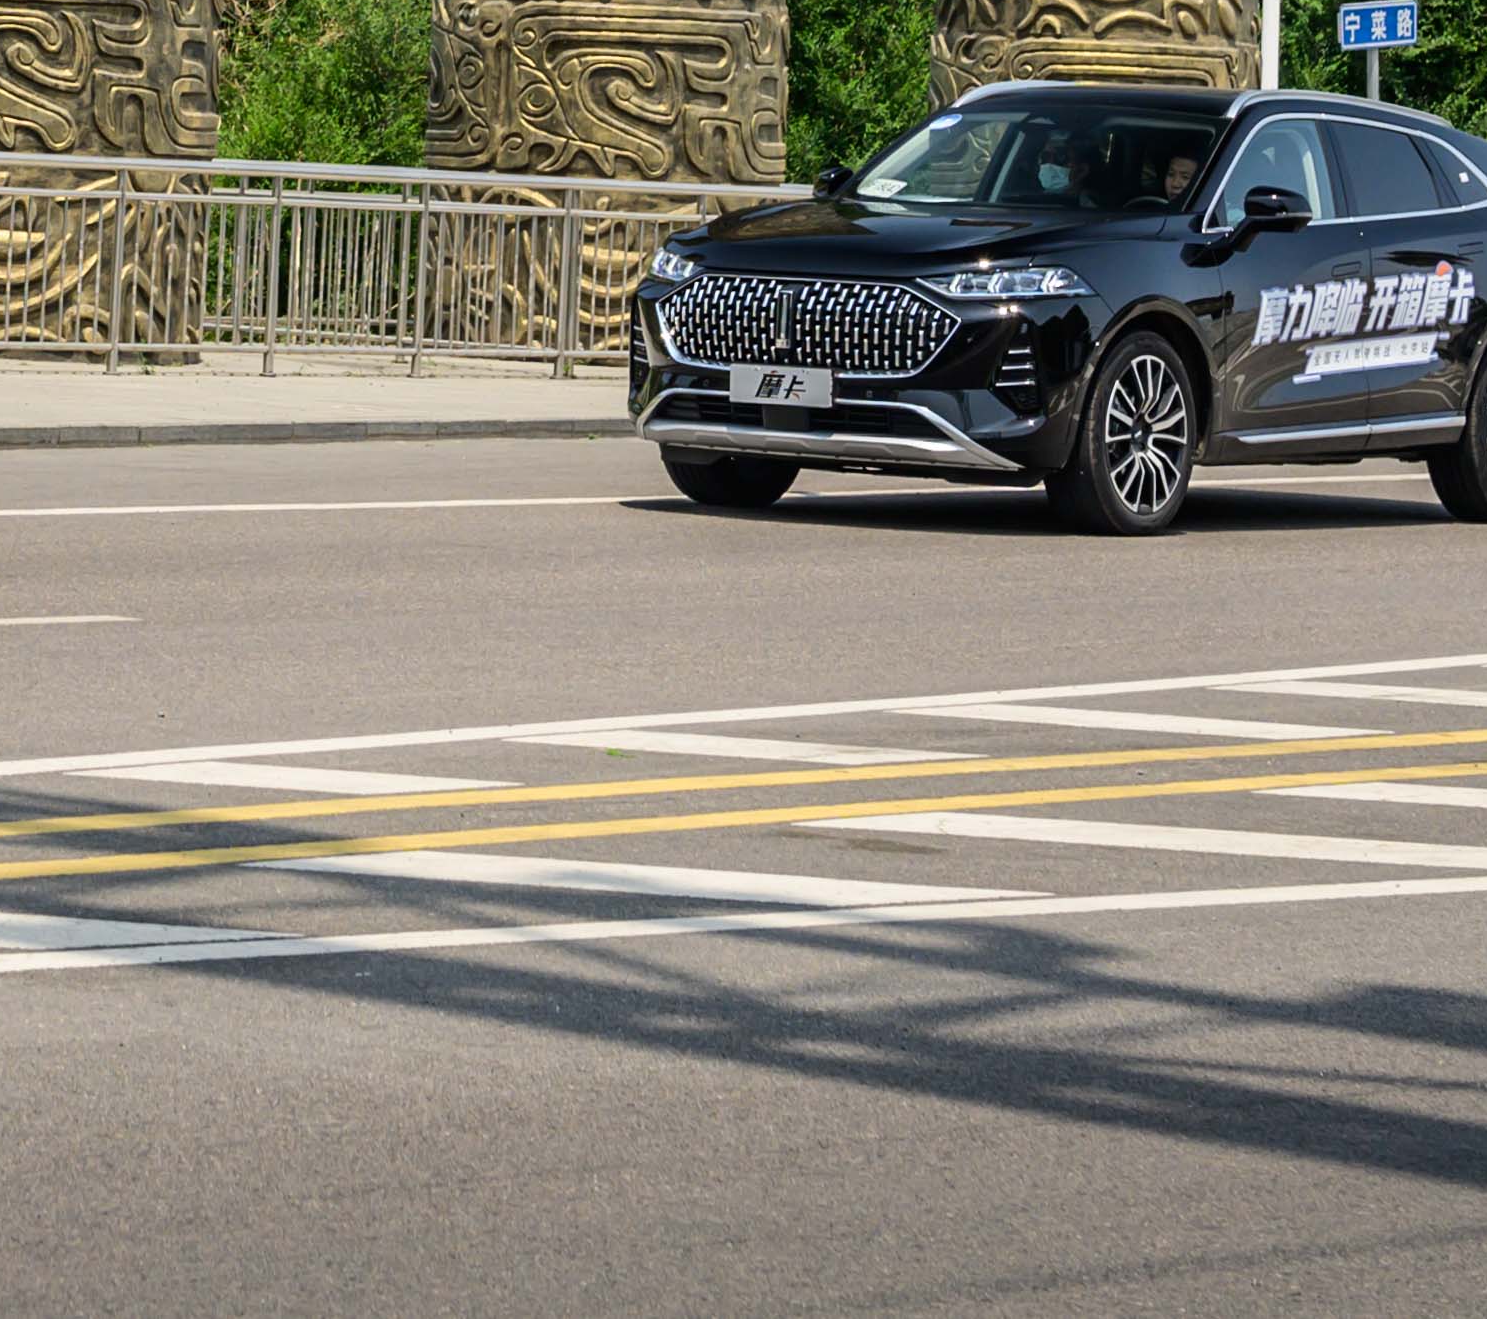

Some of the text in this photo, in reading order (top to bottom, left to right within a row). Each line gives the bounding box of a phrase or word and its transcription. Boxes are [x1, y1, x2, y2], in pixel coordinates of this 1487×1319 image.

[1364, 265, 1475, 332] 开箱摩卡
[755, 371, 806, 400] 摩卡
